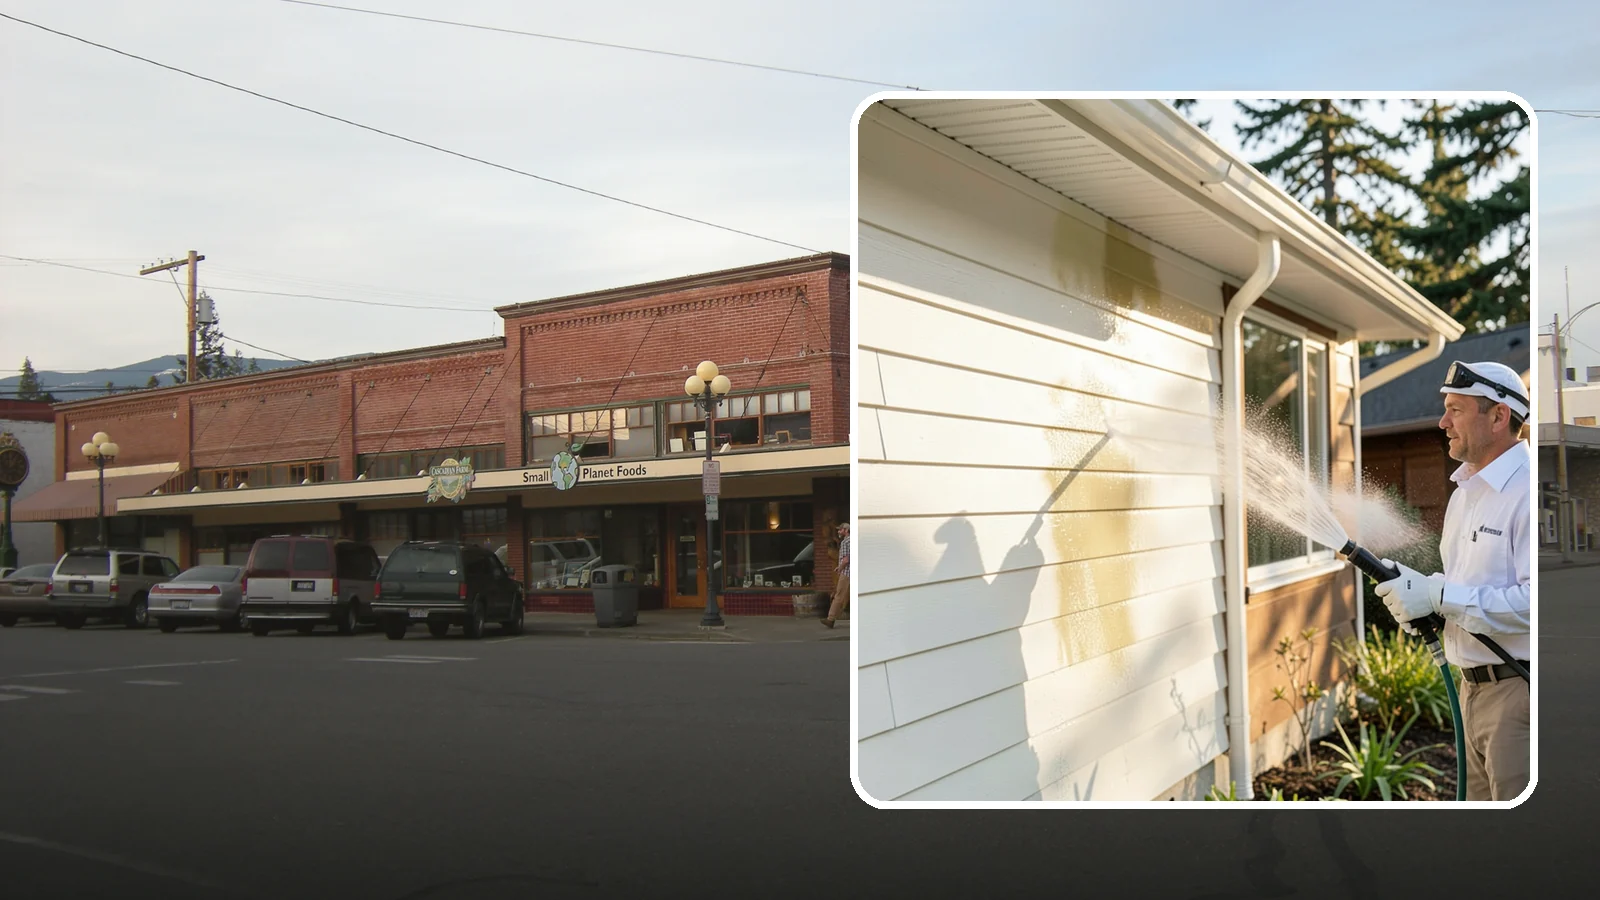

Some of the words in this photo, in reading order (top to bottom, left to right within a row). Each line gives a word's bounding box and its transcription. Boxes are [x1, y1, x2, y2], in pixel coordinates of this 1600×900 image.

[523, 471, 549, 483] Small
[582, 467, 614, 479] Planet
[616, 464, 647, 477] Foods
